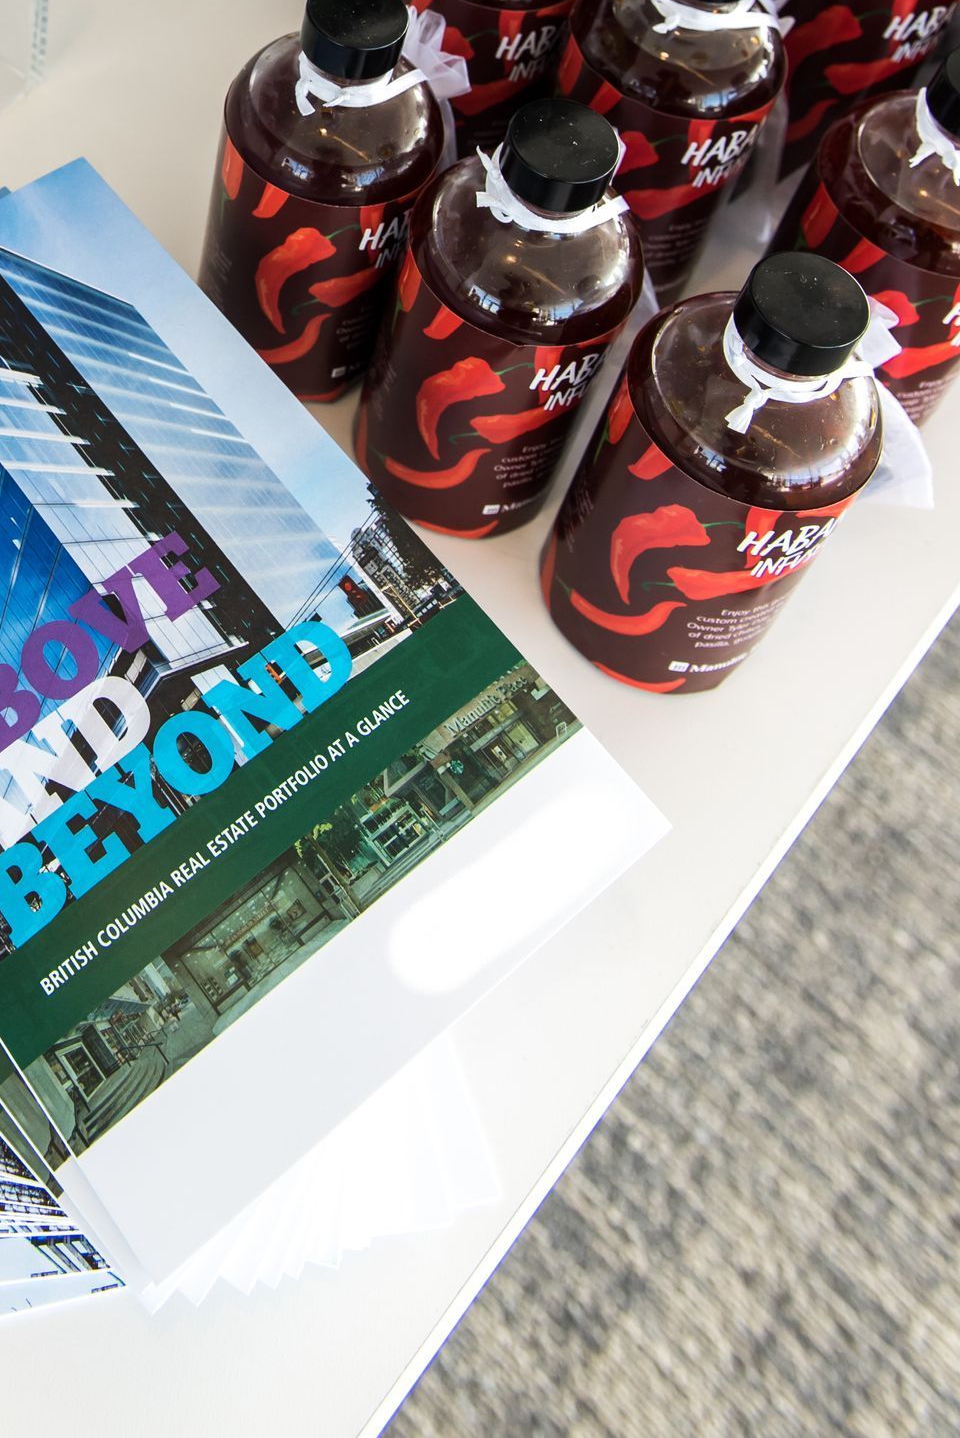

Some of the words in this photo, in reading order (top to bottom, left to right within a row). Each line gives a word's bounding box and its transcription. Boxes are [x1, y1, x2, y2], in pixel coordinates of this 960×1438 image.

[687, 622, 725, 633] Owner
[39, 946, 99, 997] BRITISH
[97, 881, 175, 949] COLUMBIA
[171, 851, 211, 889] REAL
[207, 810, 259, 858] ESTATE
[254, 754, 330, 819] PORTFOLIO
[326, 737, 348, 763] AT
[344, 730, 359, 749] A
[356, 689, 411, 738] GLANCE
